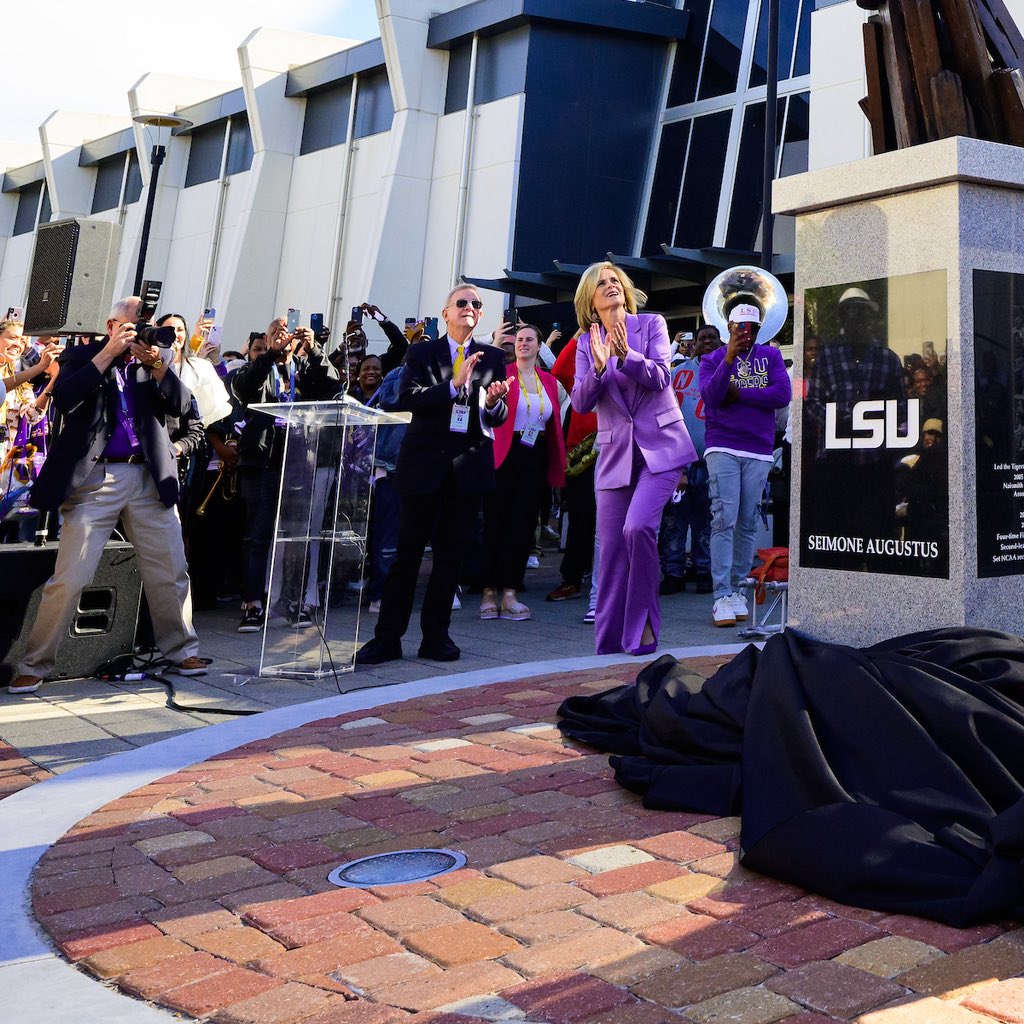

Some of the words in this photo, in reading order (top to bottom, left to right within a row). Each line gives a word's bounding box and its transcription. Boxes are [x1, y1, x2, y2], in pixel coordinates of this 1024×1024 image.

[825, 398, 920, 450] LSU
[1011, 463, 1024, 471] Tigers
[1003, 481, 1023, 489] Naismith
[808, 534, 864, 554] SEIMONE
[866, 538, 939, 558] AUGUSTUS
